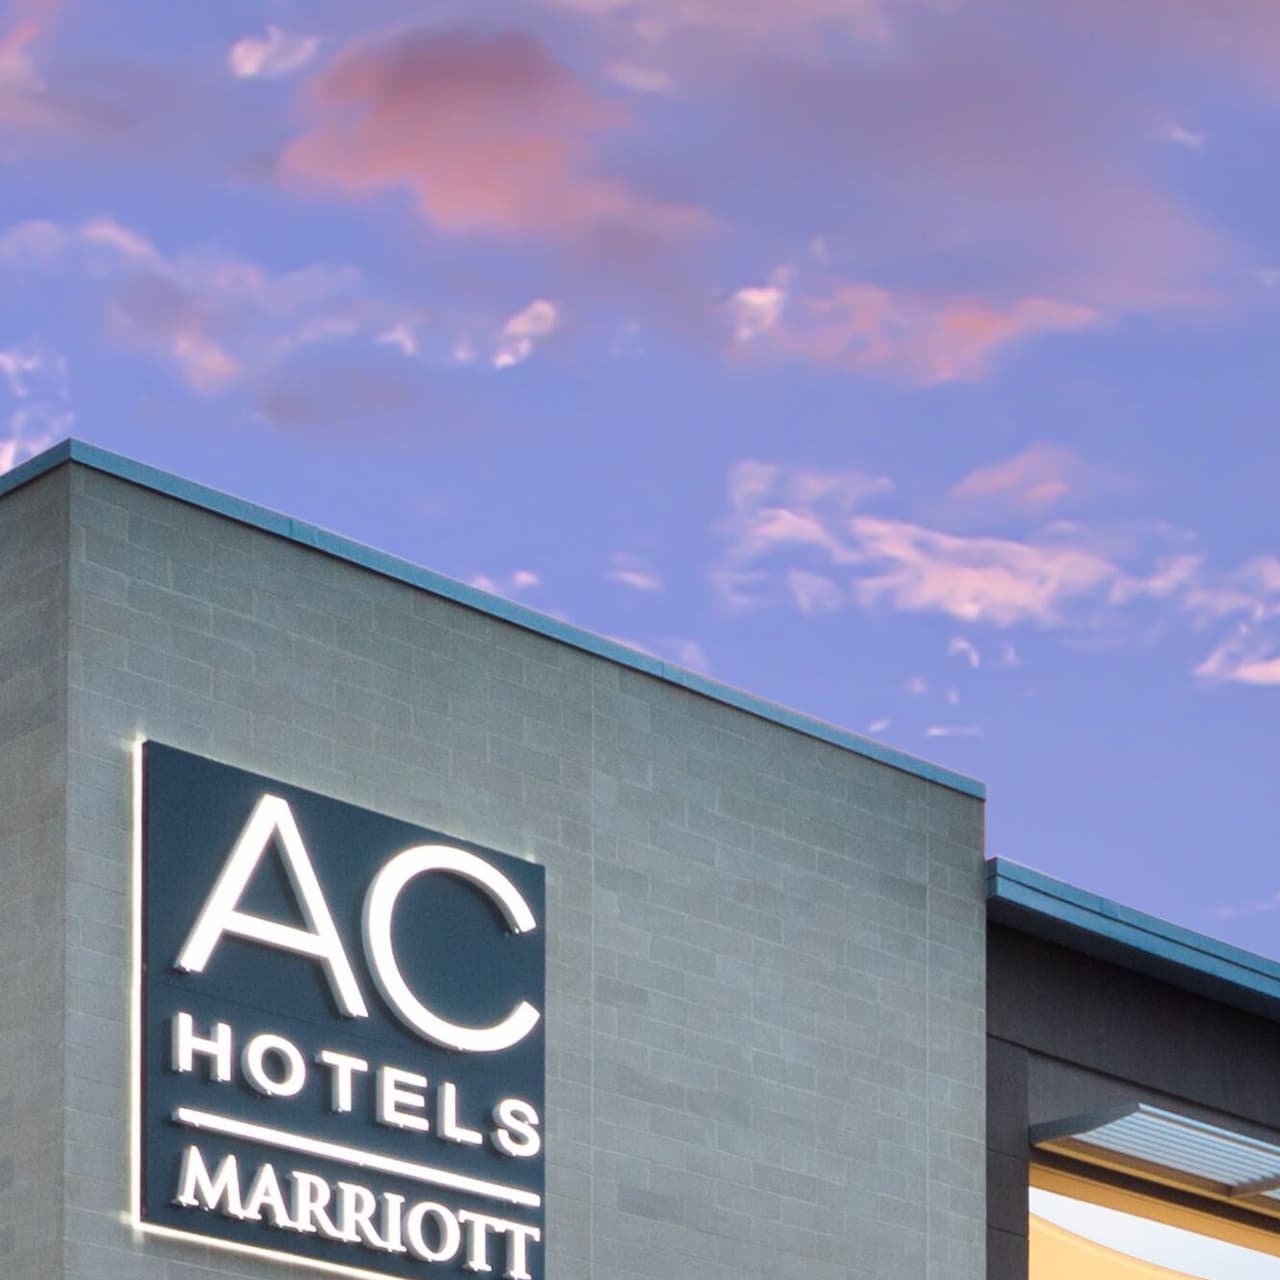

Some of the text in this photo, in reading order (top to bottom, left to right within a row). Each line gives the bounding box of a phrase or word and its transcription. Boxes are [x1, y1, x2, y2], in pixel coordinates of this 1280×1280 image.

[174, 794, 540, 1052] AC
[172, 1012, 541, 1156] HOTELS
[174, 1145, 541, 1280] MARRIOTT
